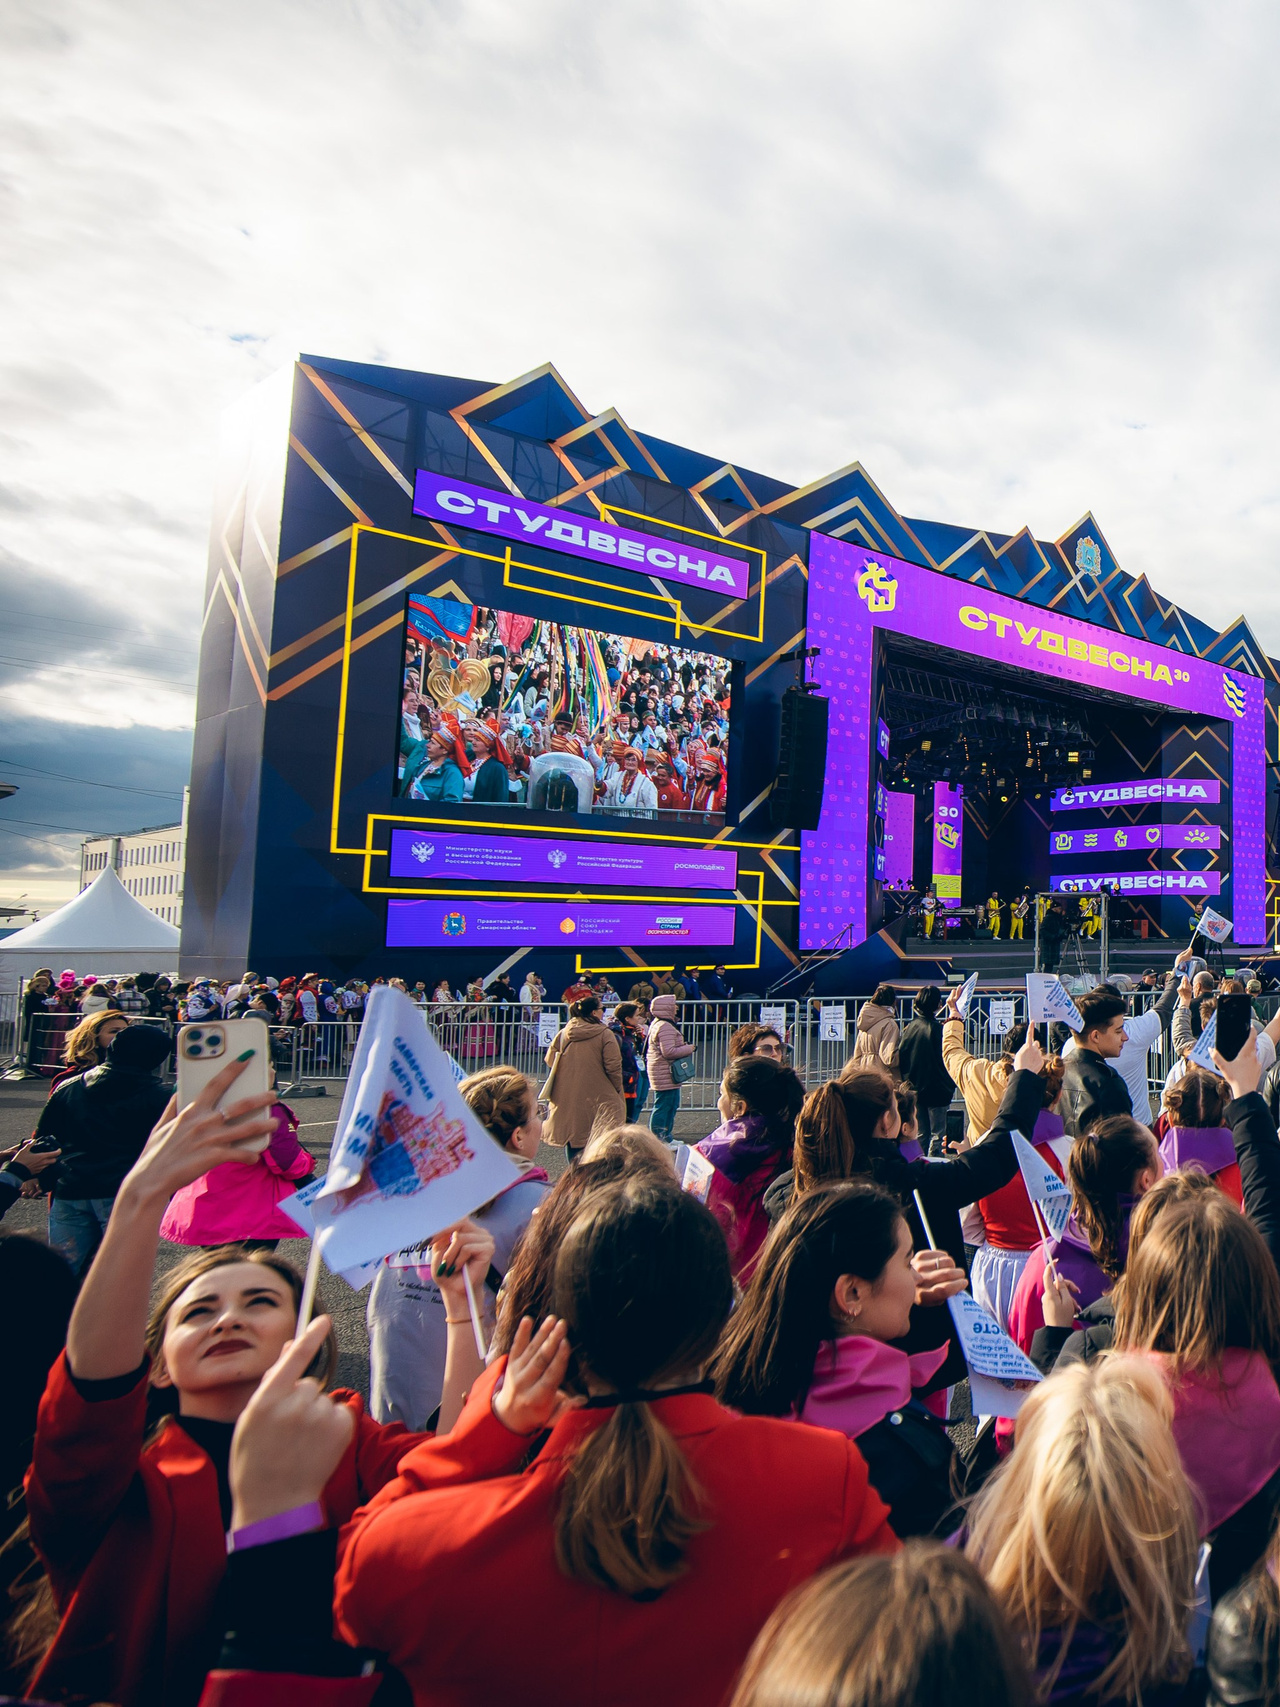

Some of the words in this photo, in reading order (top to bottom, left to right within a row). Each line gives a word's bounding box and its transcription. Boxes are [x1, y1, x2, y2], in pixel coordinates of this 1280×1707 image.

[435, 489, 736, 587] СТУДВЕСНА
[958, 605, 1174, 686] СТУДВЕСНА
[1060, 785, 1208, 806] СТУДВЕСНА
[938, 806, 959, 818] 30
[445, 845, 493, 853] Министерство
[1060, 875, 1208, 893] СТУДВЕСНА
[389, 1059, 414, 1097] ЛАСТЬ
[393, 1036, 434, 1100] САМАРСКАЯ
